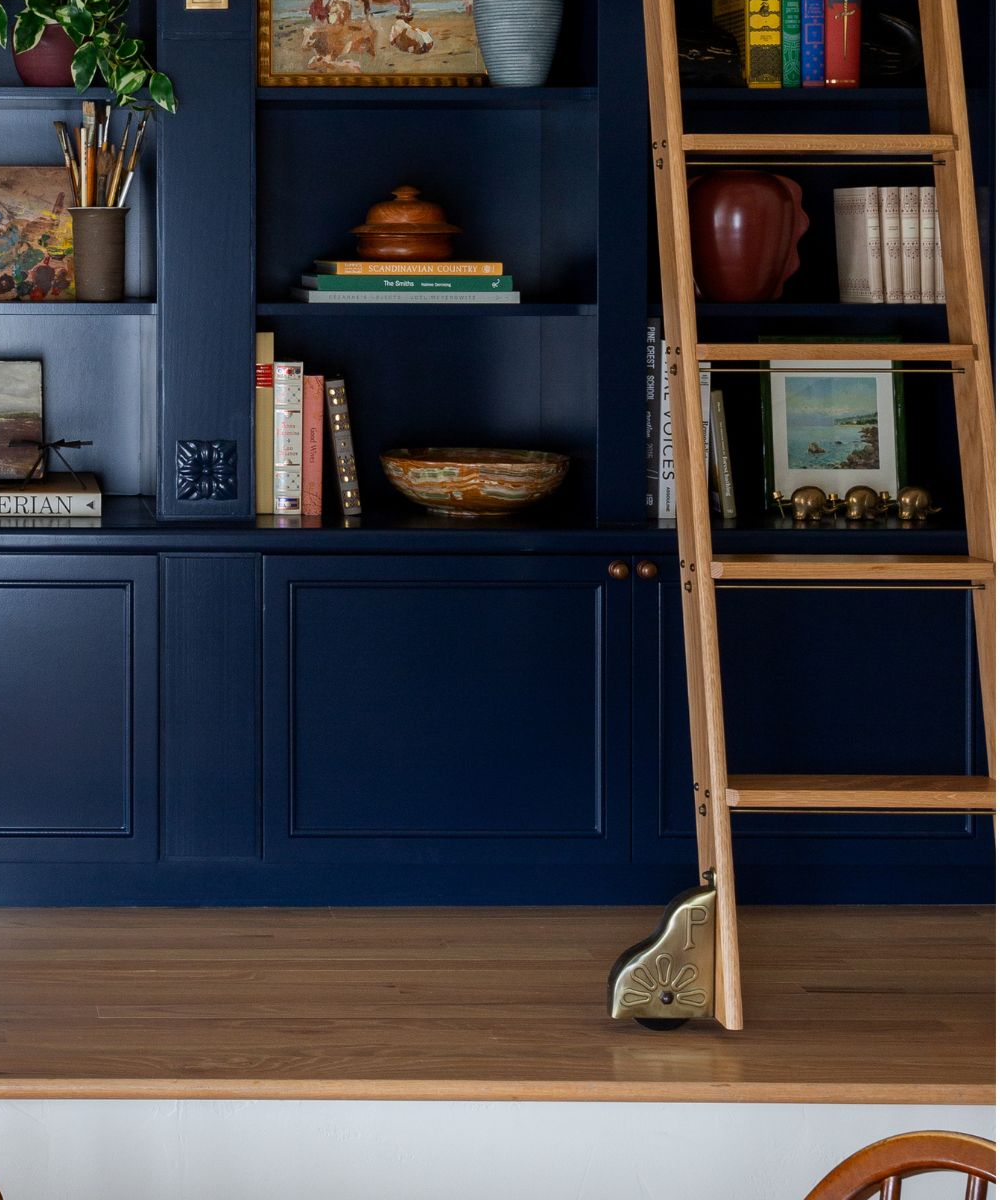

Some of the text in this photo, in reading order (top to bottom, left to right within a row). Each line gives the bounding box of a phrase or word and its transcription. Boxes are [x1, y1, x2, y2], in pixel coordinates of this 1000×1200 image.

[368, 264, 434, 273] SCANDINAVIAN
[437, 264, 478, 273] COUNTRY
[646, 326, 656, 400] PINE CREST SCHOOL
[662, 410, 674, 480] VOICES
